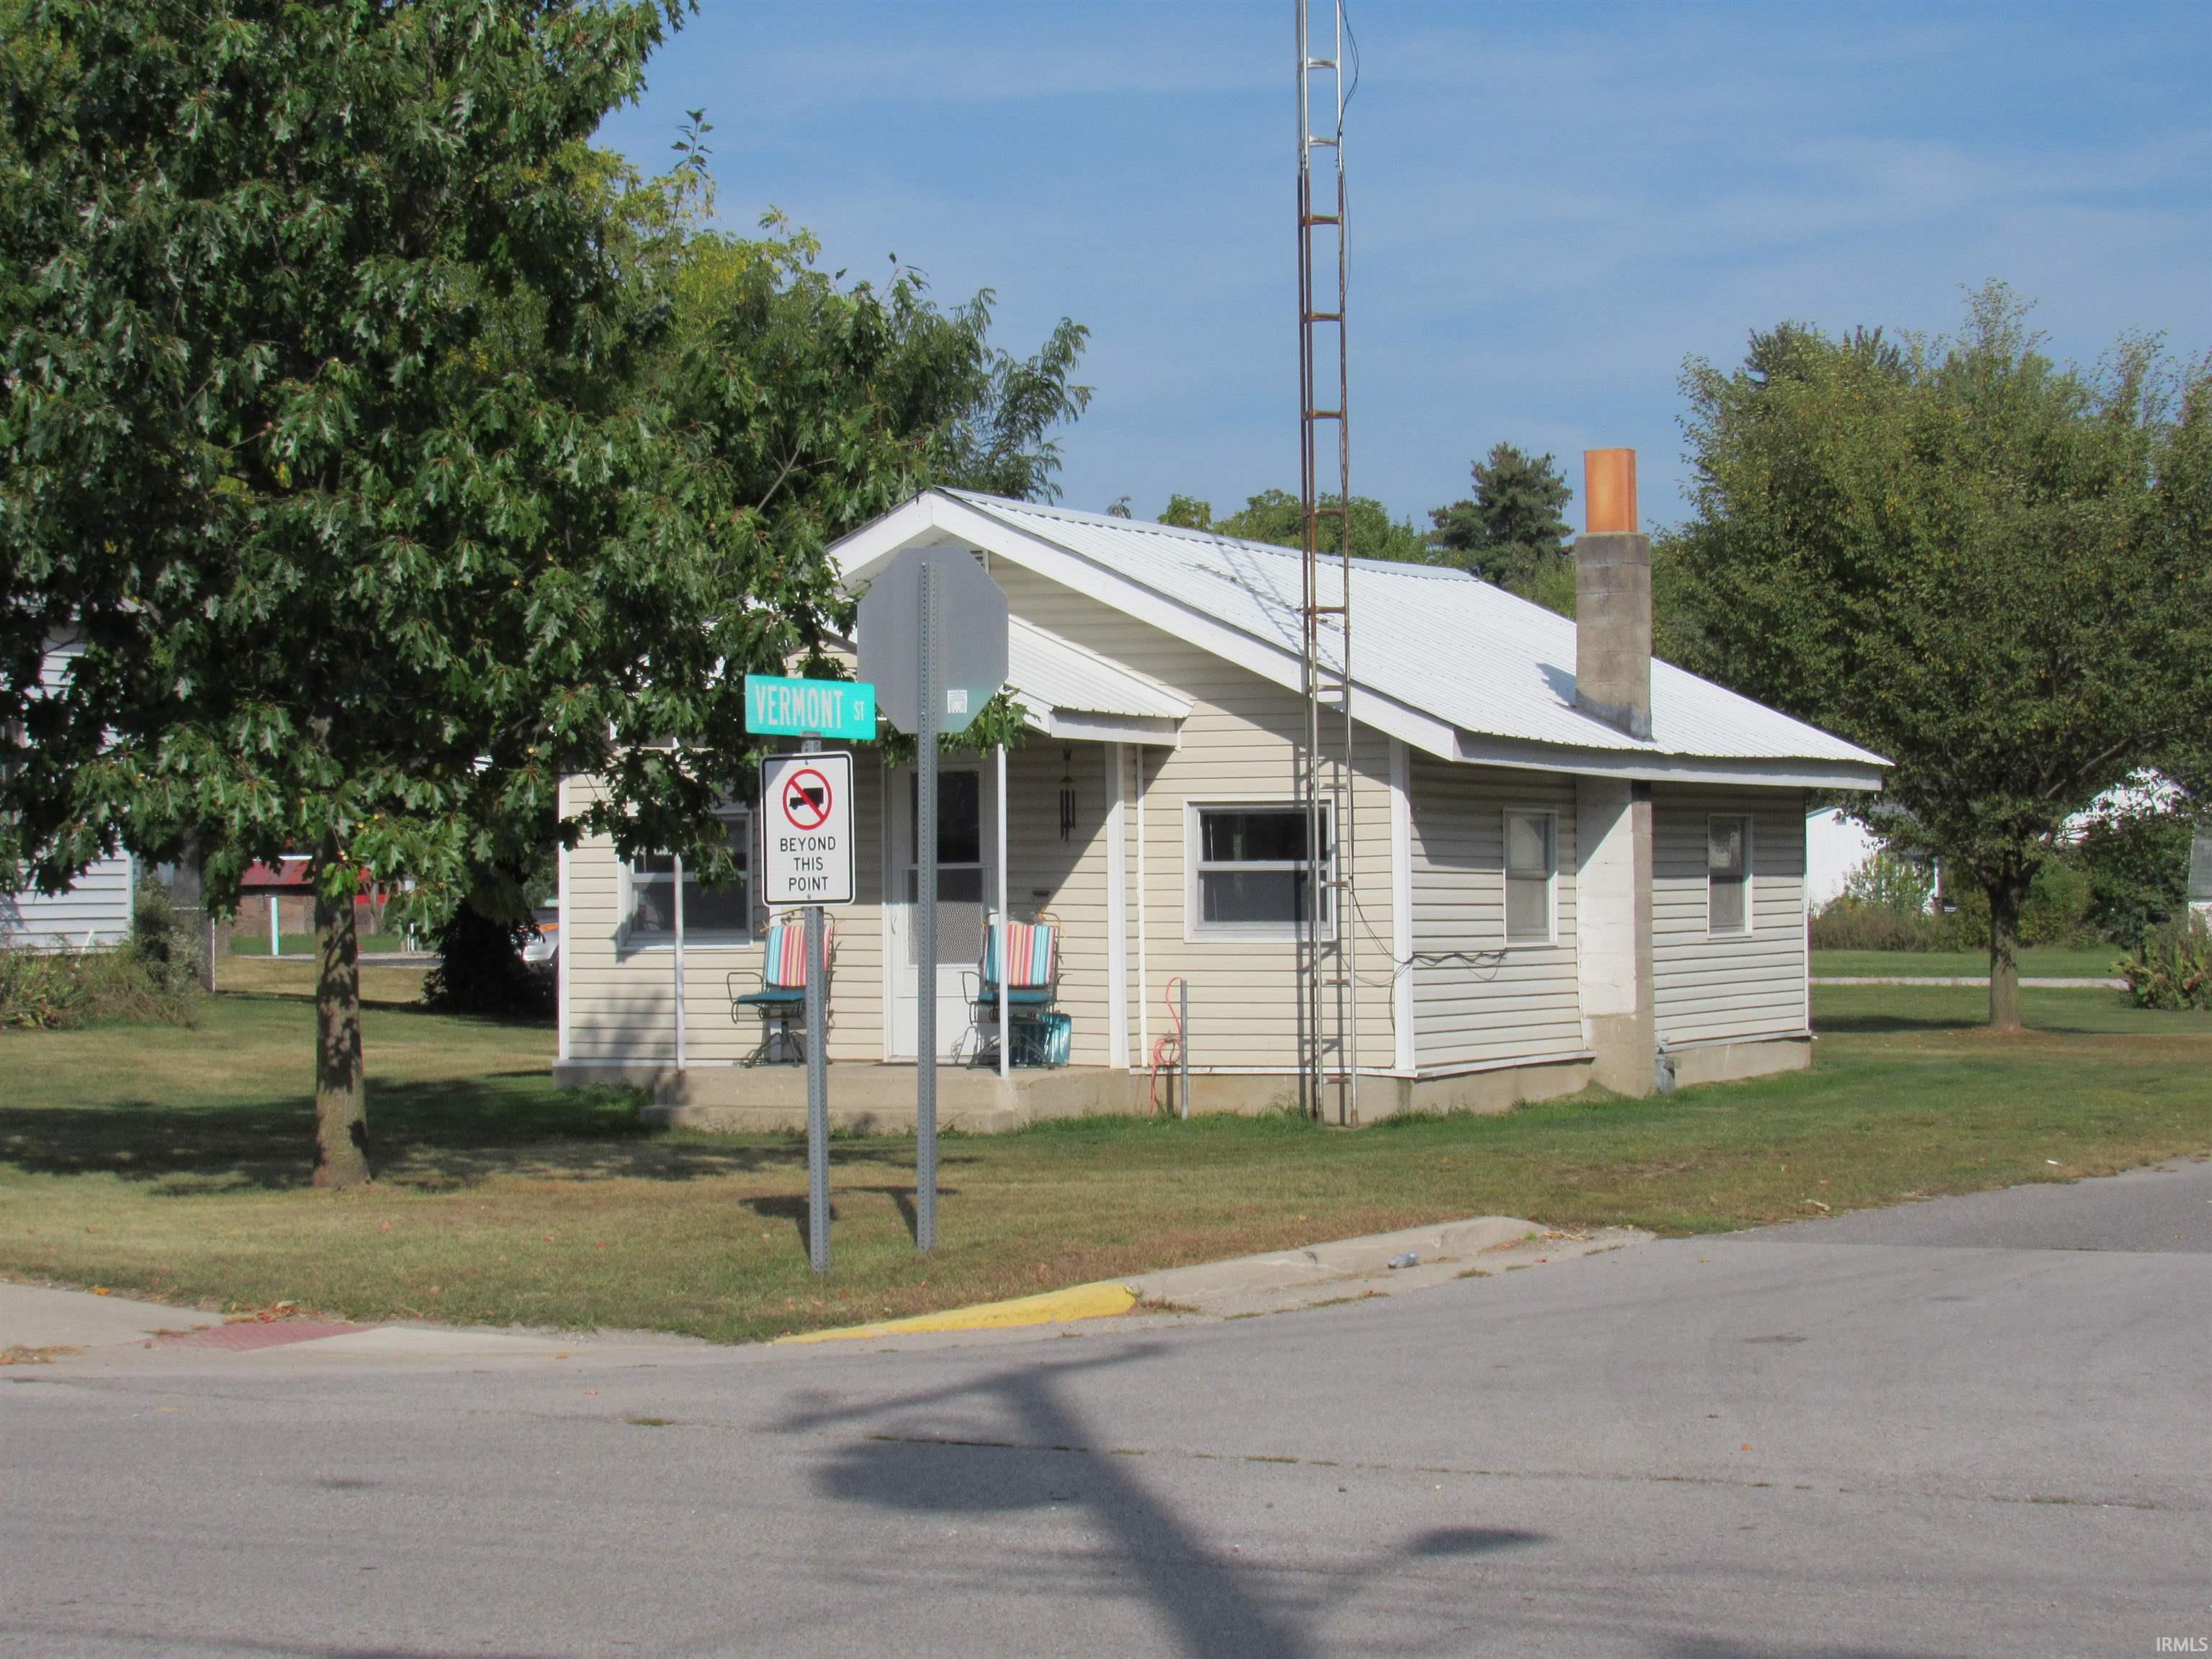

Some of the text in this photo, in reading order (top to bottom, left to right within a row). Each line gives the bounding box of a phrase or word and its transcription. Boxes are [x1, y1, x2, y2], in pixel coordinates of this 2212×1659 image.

[755, 684, 864, 729] VERMONT ST
[780, 836, 836, 852] BEYOND
[793, 857, 824, 871] THIS
[788, 876, 828, 891] POINT
